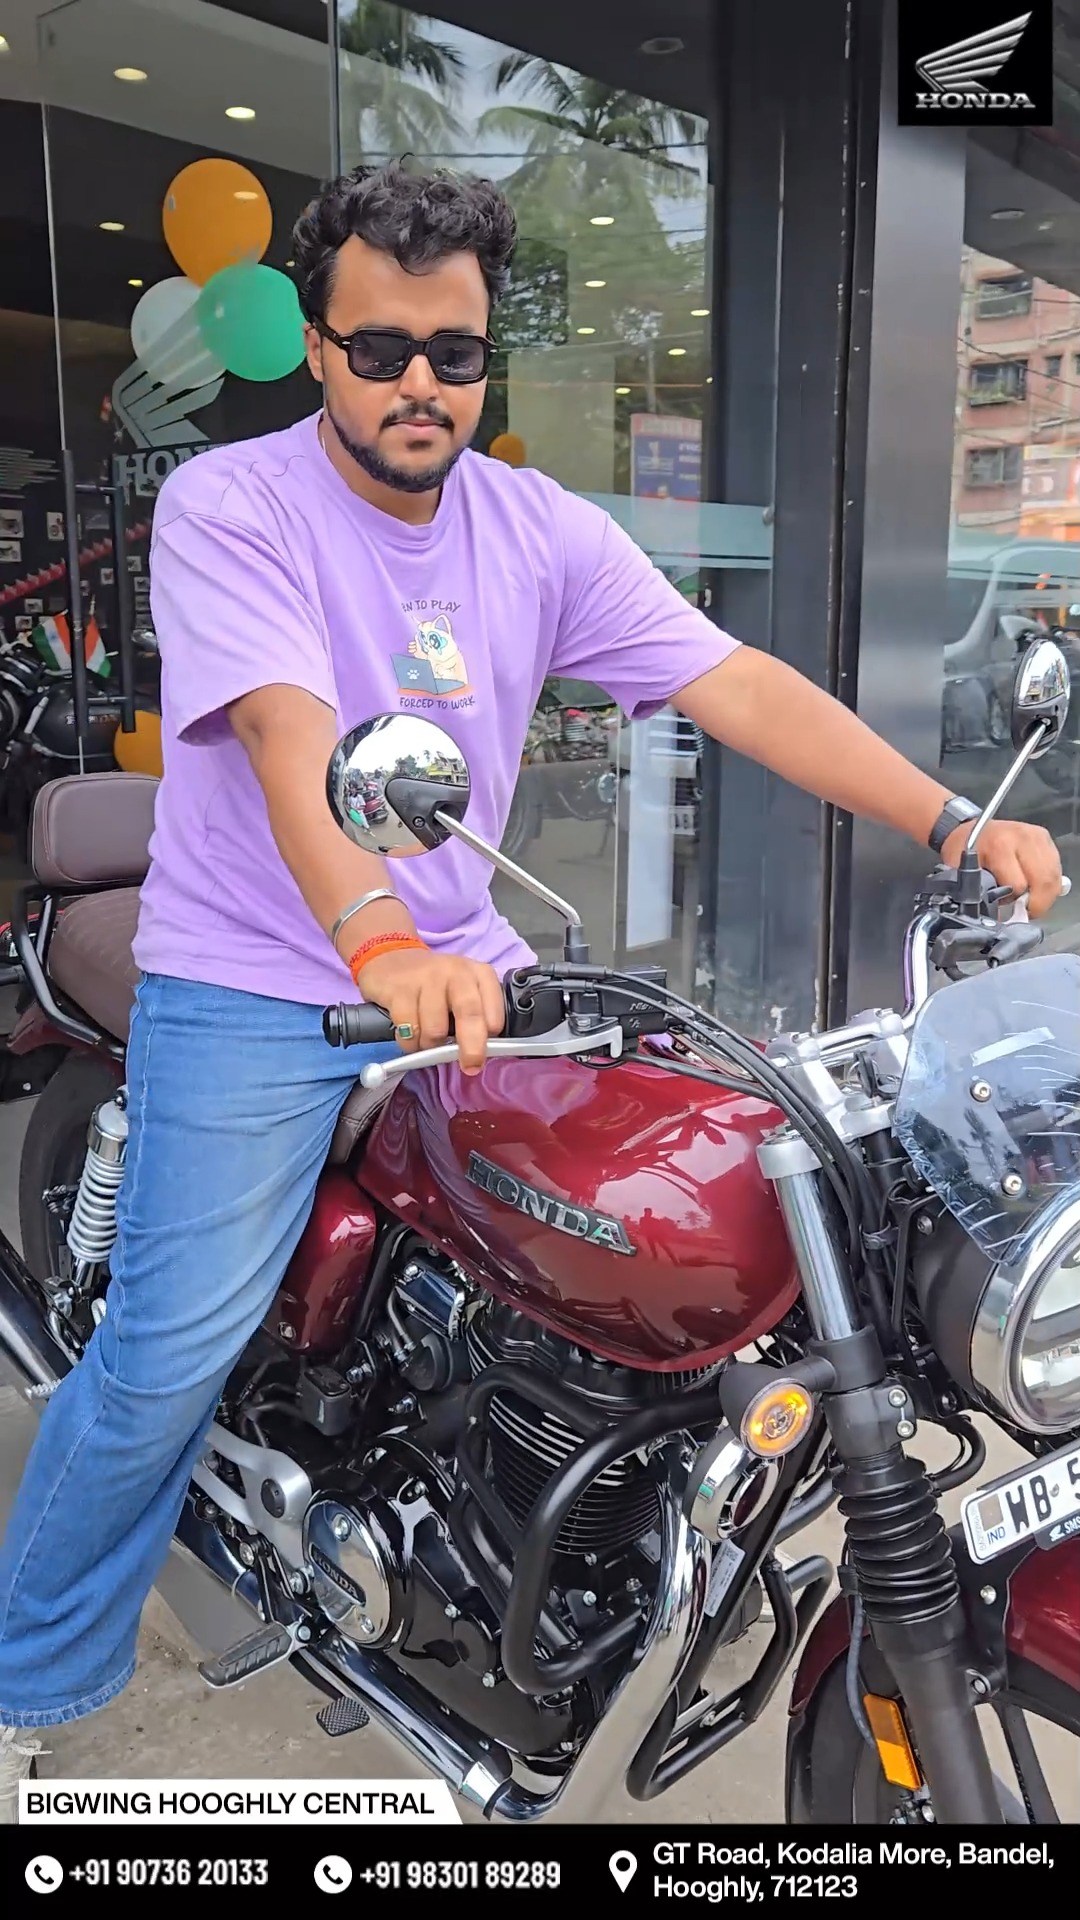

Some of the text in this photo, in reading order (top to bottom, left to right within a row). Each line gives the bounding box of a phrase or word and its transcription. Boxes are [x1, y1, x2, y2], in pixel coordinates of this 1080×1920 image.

[416, 600, 427, 610] TO
[431, 600, 461, 613] PLAY
[400, 695, 475, 710] FORCED TO WORK
[465, 1155, 637, 1255] HONDA
[987, 1526, 1006, 1545] IND
